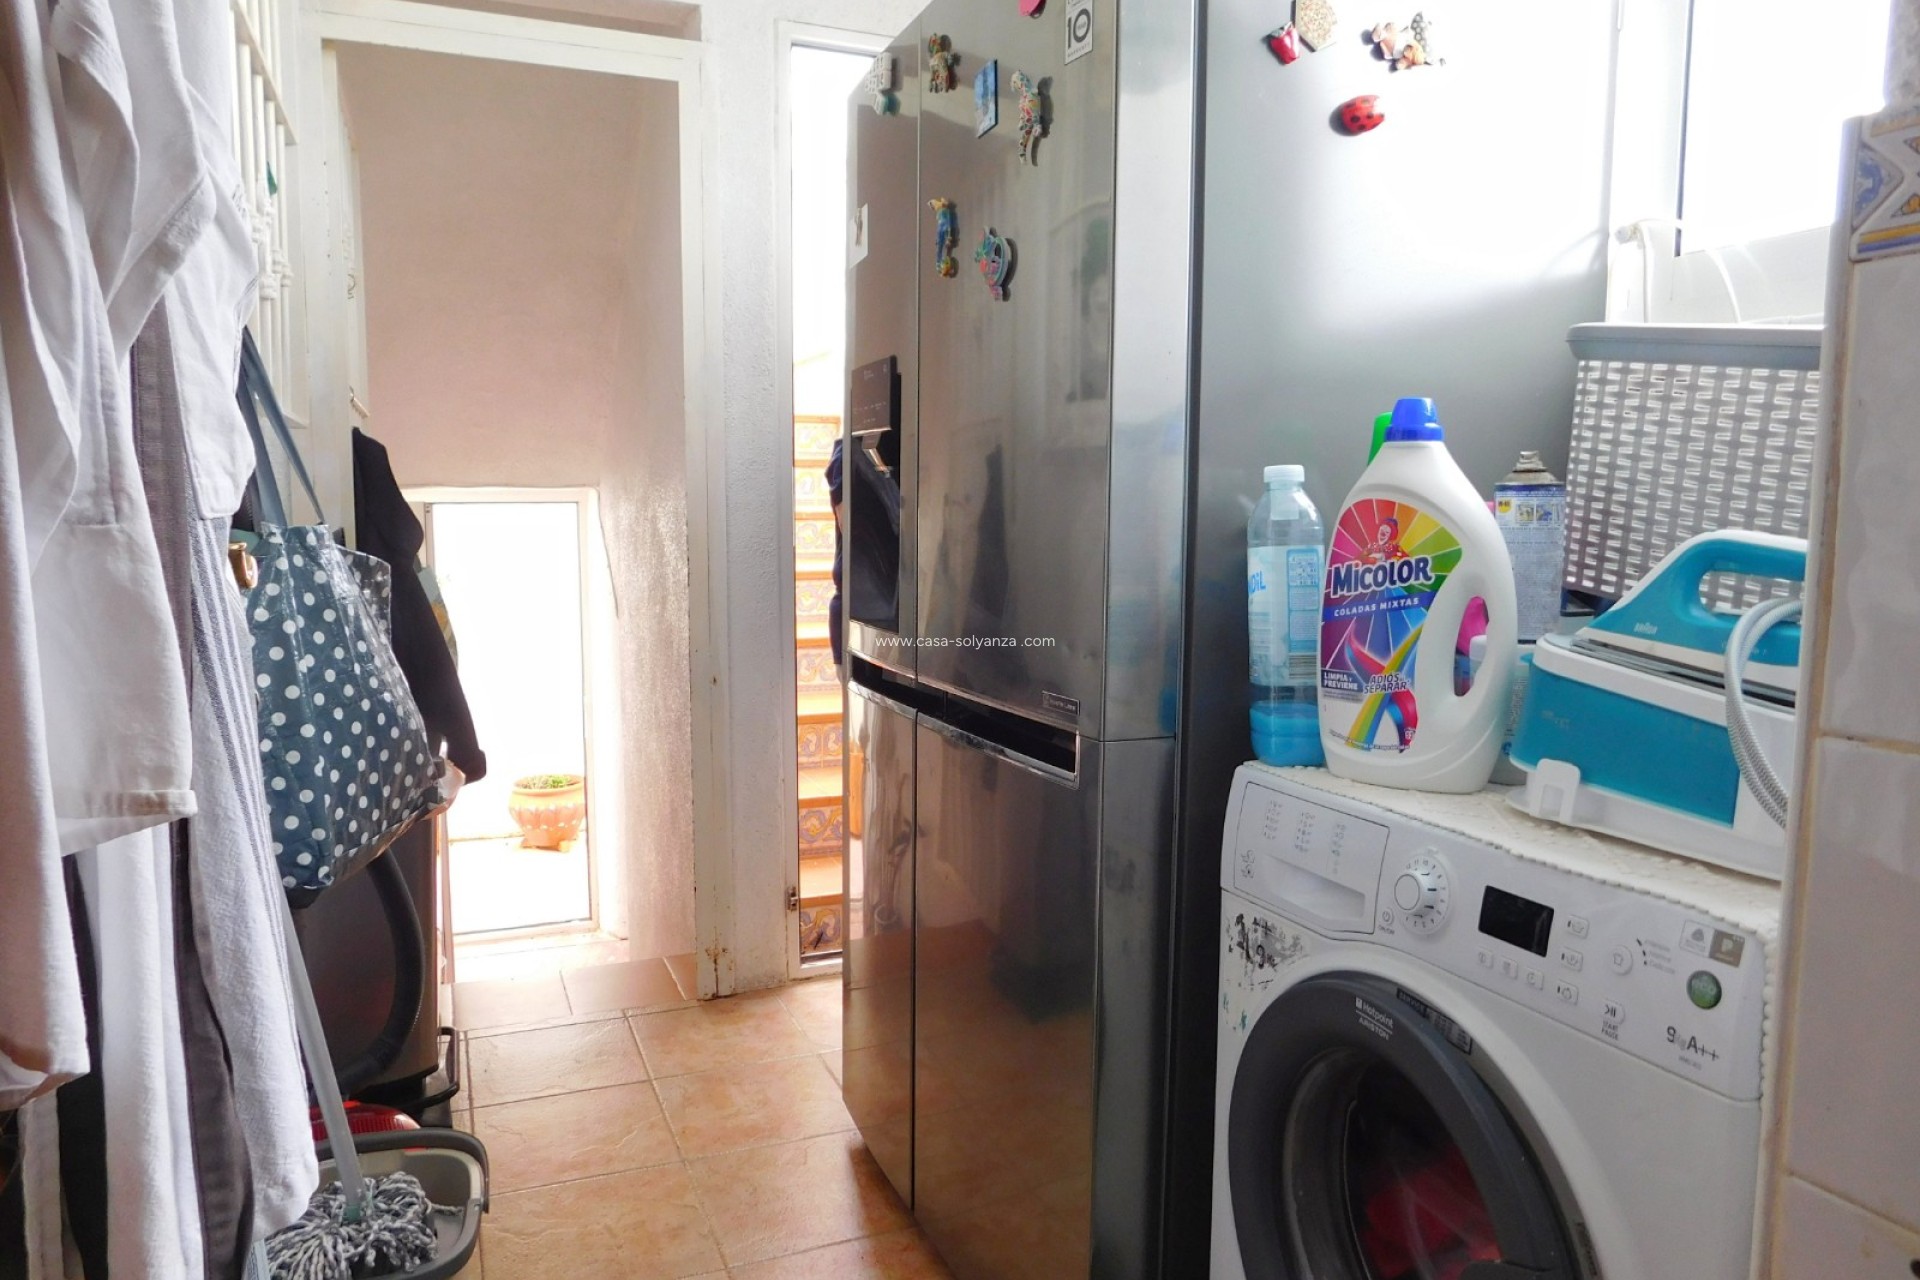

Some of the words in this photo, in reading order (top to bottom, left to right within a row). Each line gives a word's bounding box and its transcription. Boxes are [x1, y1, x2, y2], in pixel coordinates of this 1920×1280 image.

[1067, 8, 1091, 49] 10
[1334, 603, 1376, 617] COLADAS
[1379, 597, 1420, 610] MIXTAS
